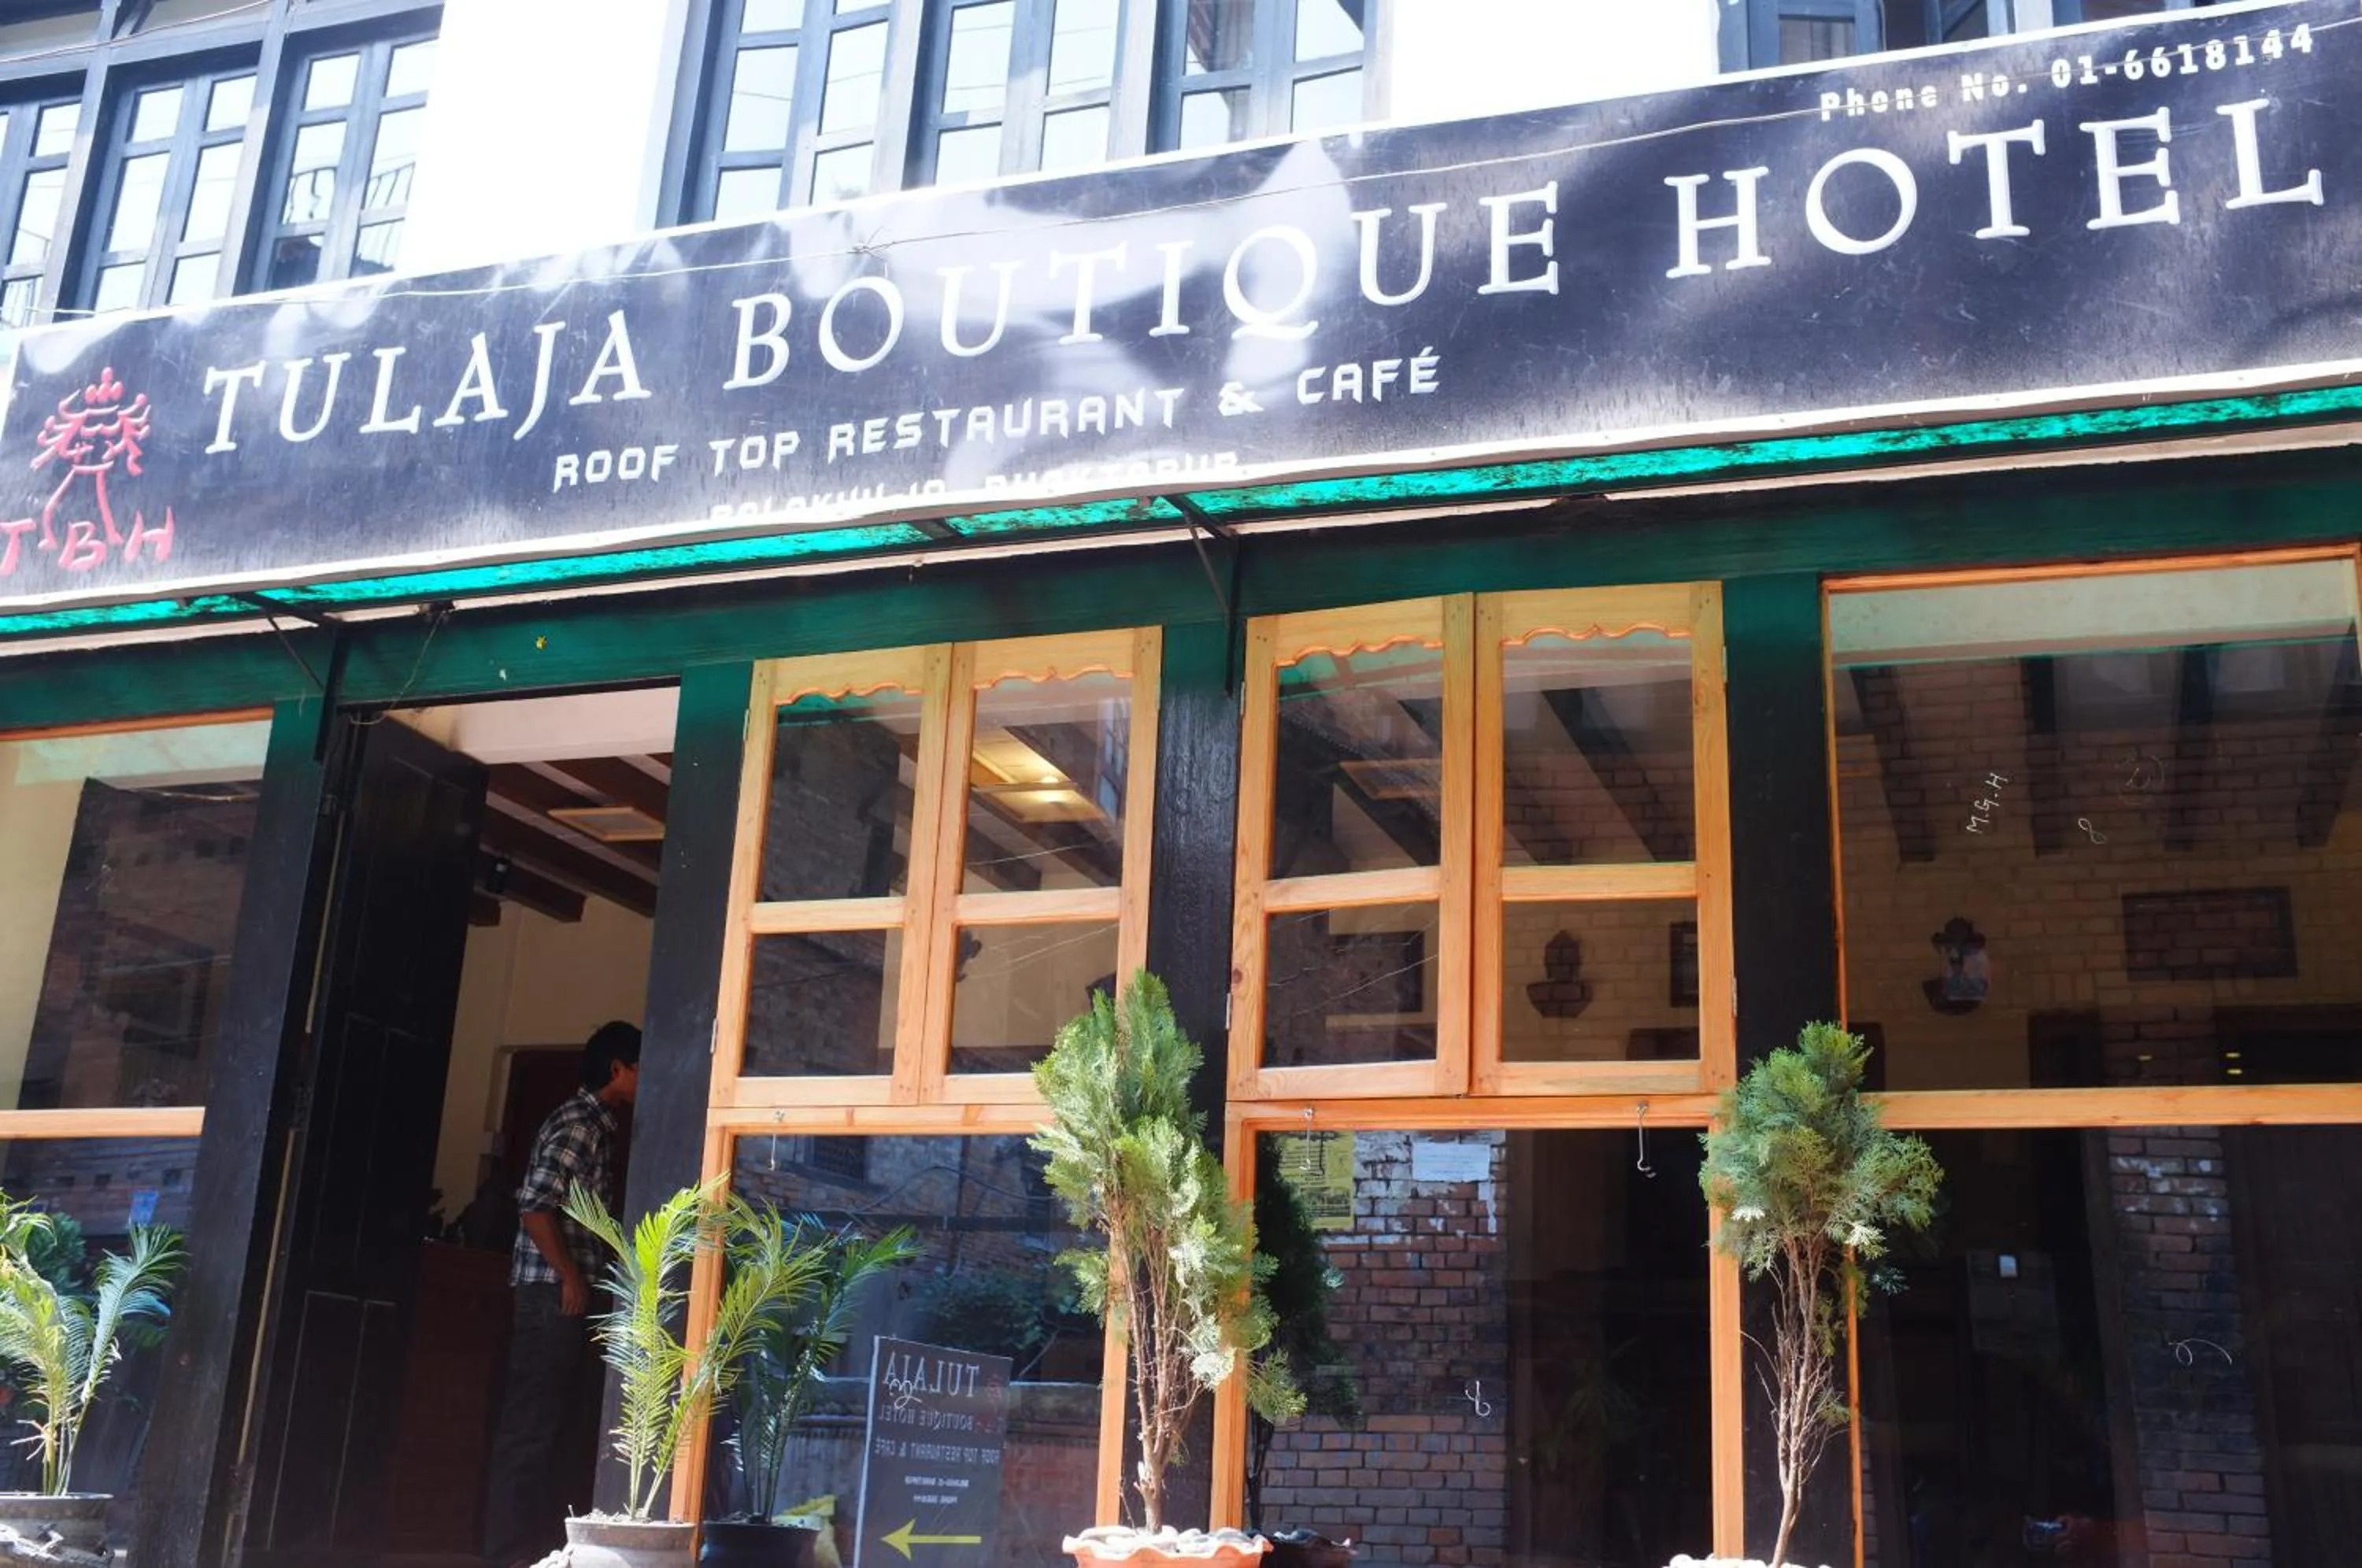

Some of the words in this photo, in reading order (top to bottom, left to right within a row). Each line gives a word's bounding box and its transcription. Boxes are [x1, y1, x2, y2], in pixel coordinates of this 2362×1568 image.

[1821, 83, 1939, 122] Phone
[1962, 73, 2028, 103] No.
[2051, 24, 2314, 89] 01-6618144
[203, 310, 653, 454] TULAJA
[722, 180, 1559, 390] BOUTIQUE
[1663, 98, 2324, 279] HOTEL
[553, 444, 679, 493] ROOF
[709, 431, 801, 477] TOP
[827, 386, 1185, 464] RESTAURANT
[1218, 381, 1264, 417] &
[1297, 346, 1441, 405] CAFÉ
